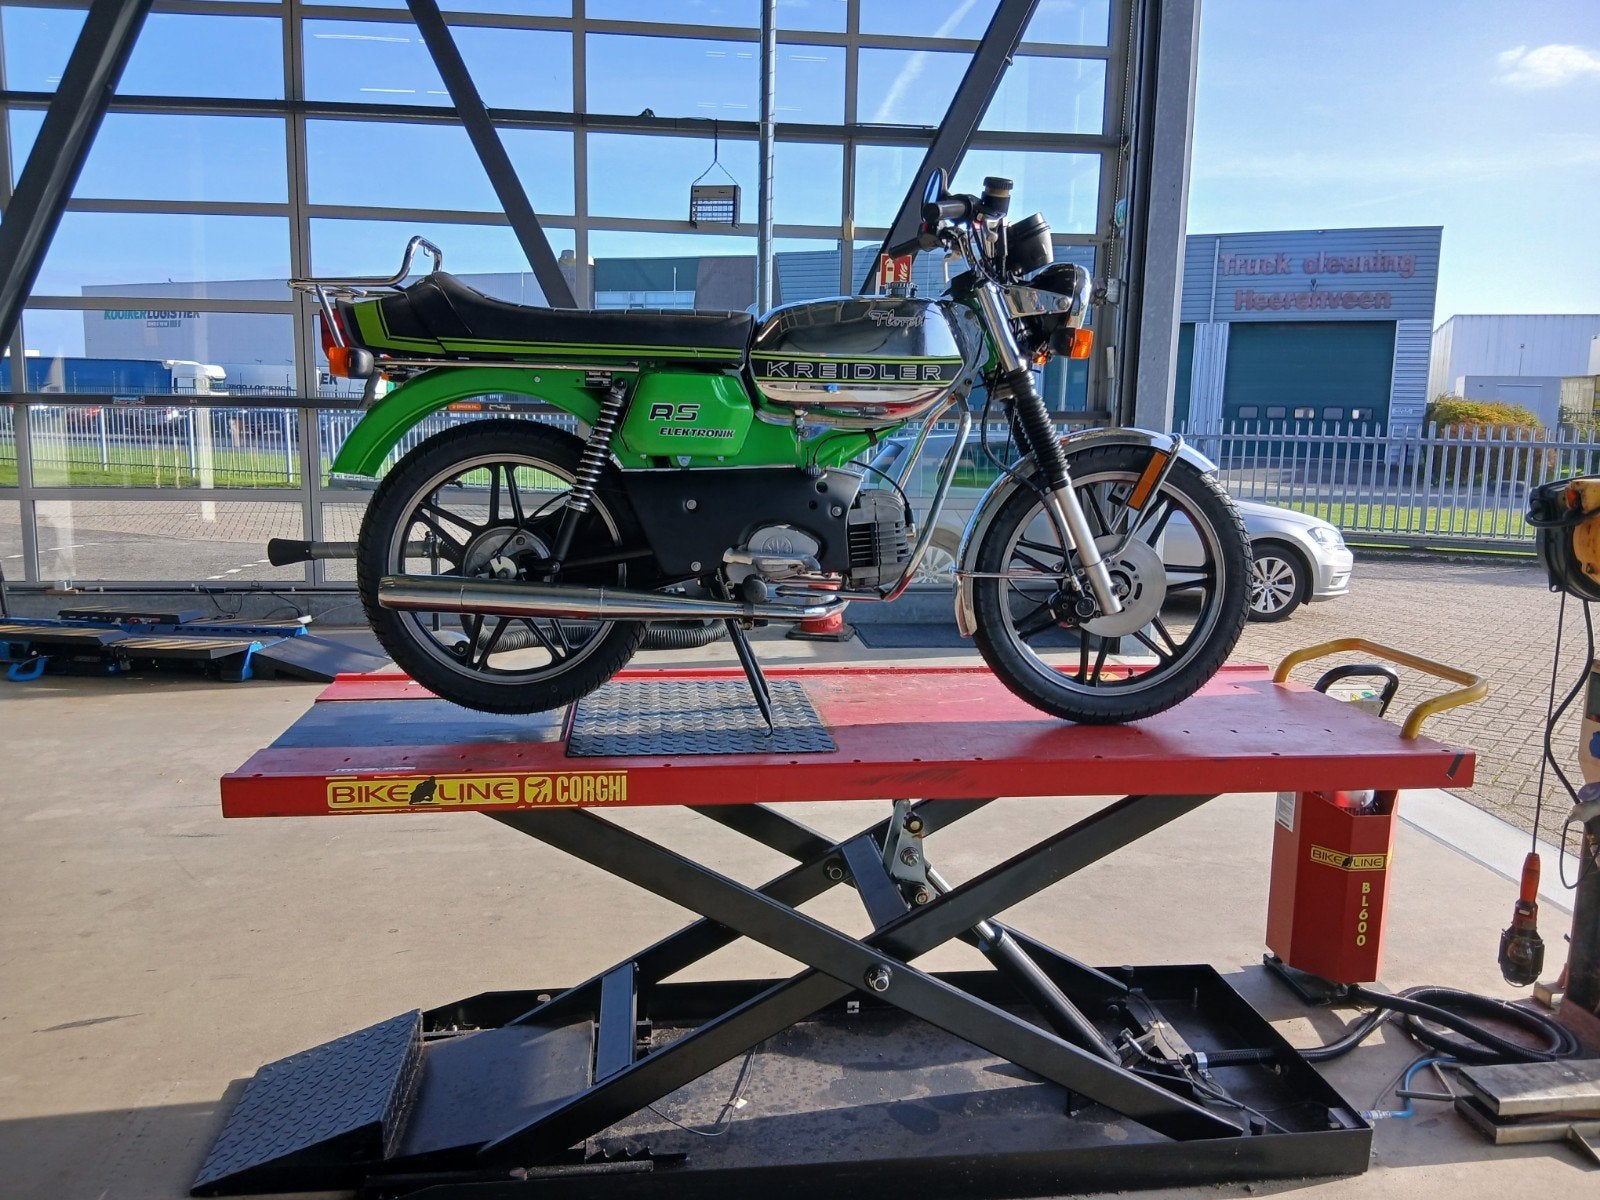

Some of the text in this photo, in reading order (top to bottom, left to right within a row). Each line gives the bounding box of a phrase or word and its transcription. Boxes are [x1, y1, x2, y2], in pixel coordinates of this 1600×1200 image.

[1220, 250, 1417, 279] Truck cleaning
[1234, 289, 1392, 311] Heerenveen
[766, 361, 942, 381] KREIDLER
[648, 402, 701, 422] RS
[659, 426, 736, 438] ELEKTRONIK
[331, 775, 628, 804] BIKE LINE CORGHI
[1312, 849, 1382, 867] BIKE LINE
[1356, 882, 1370, 946] BL600
